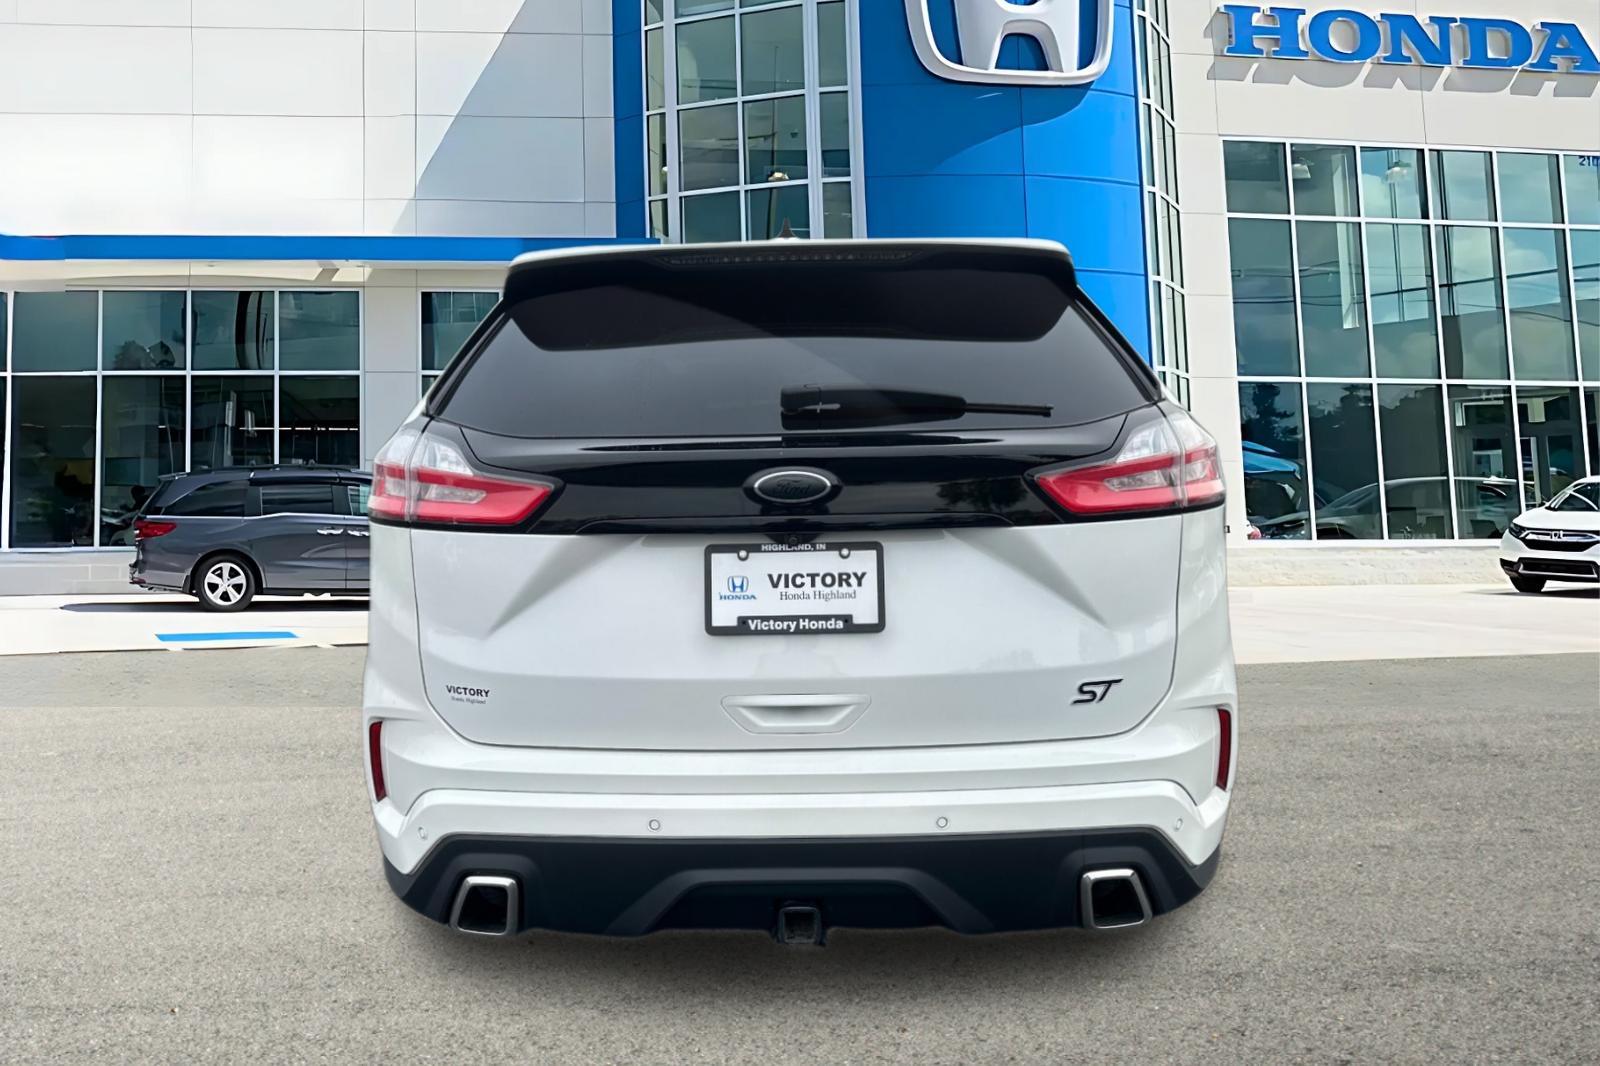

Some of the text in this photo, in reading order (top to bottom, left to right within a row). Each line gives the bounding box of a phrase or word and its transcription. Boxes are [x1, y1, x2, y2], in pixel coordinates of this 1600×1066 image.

[1220, 4, 1600, 73] HONDA
[816, 543, 827, 551] IN
[767, 572, 867, 589] VICTORY
[719, 592, 757, 601] HONDA
[779, 590, 857, 602] Honda Highland
[748, 618, 844, 632] Victory Honda
[446, 684, 490, 698] VICTORY
[1071, 678, 1124, 705] ST
